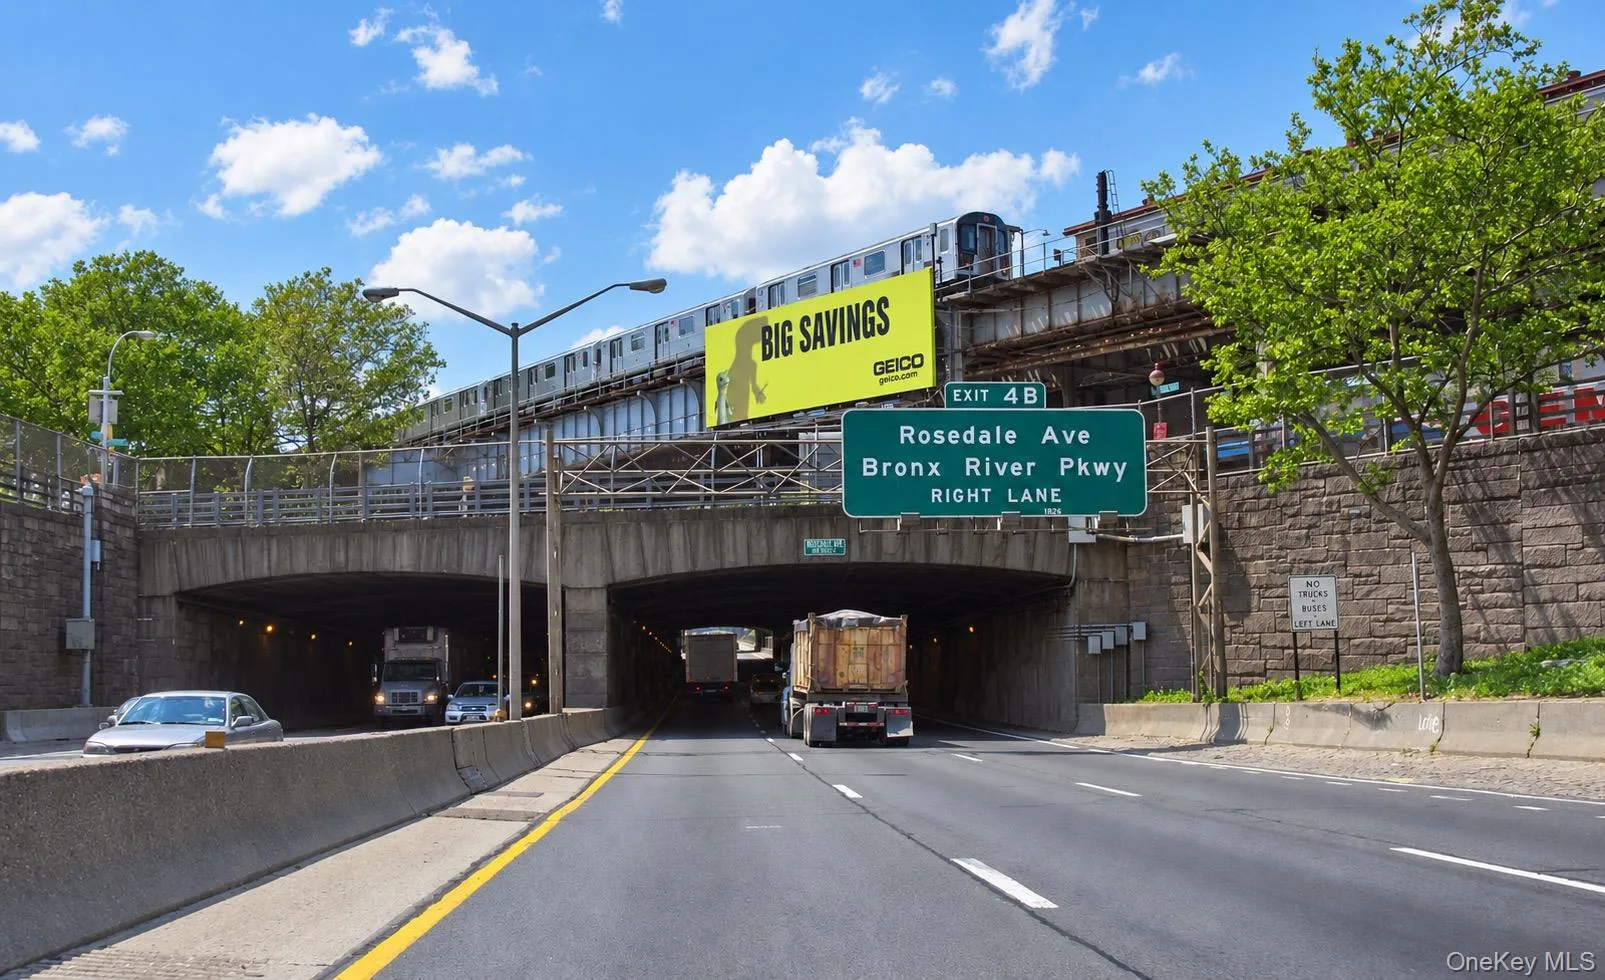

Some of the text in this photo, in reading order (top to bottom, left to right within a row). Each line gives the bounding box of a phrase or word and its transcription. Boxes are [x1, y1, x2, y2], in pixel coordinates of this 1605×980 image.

[761, 296, 890, 362] BIG SAVINGS
[873, 353, 924, 376] GEICO
[879, 371, 917, 386] geico.com
[953, 389, 989, 402] EXIT
[899, 425, 1091, 445] Rosedale Ave
[862, 457, 1128, 482] Bronx River Pkwy
[931, 488, 1062, 503] RIGHT LANE
[1306, 580, 1320, 588] NO
[1298, 590, 1329, 598] TRUCKS
[1301, 604, 1327, 612] BUSES
[1294, 619, 1336, 628] LEFT LANE
